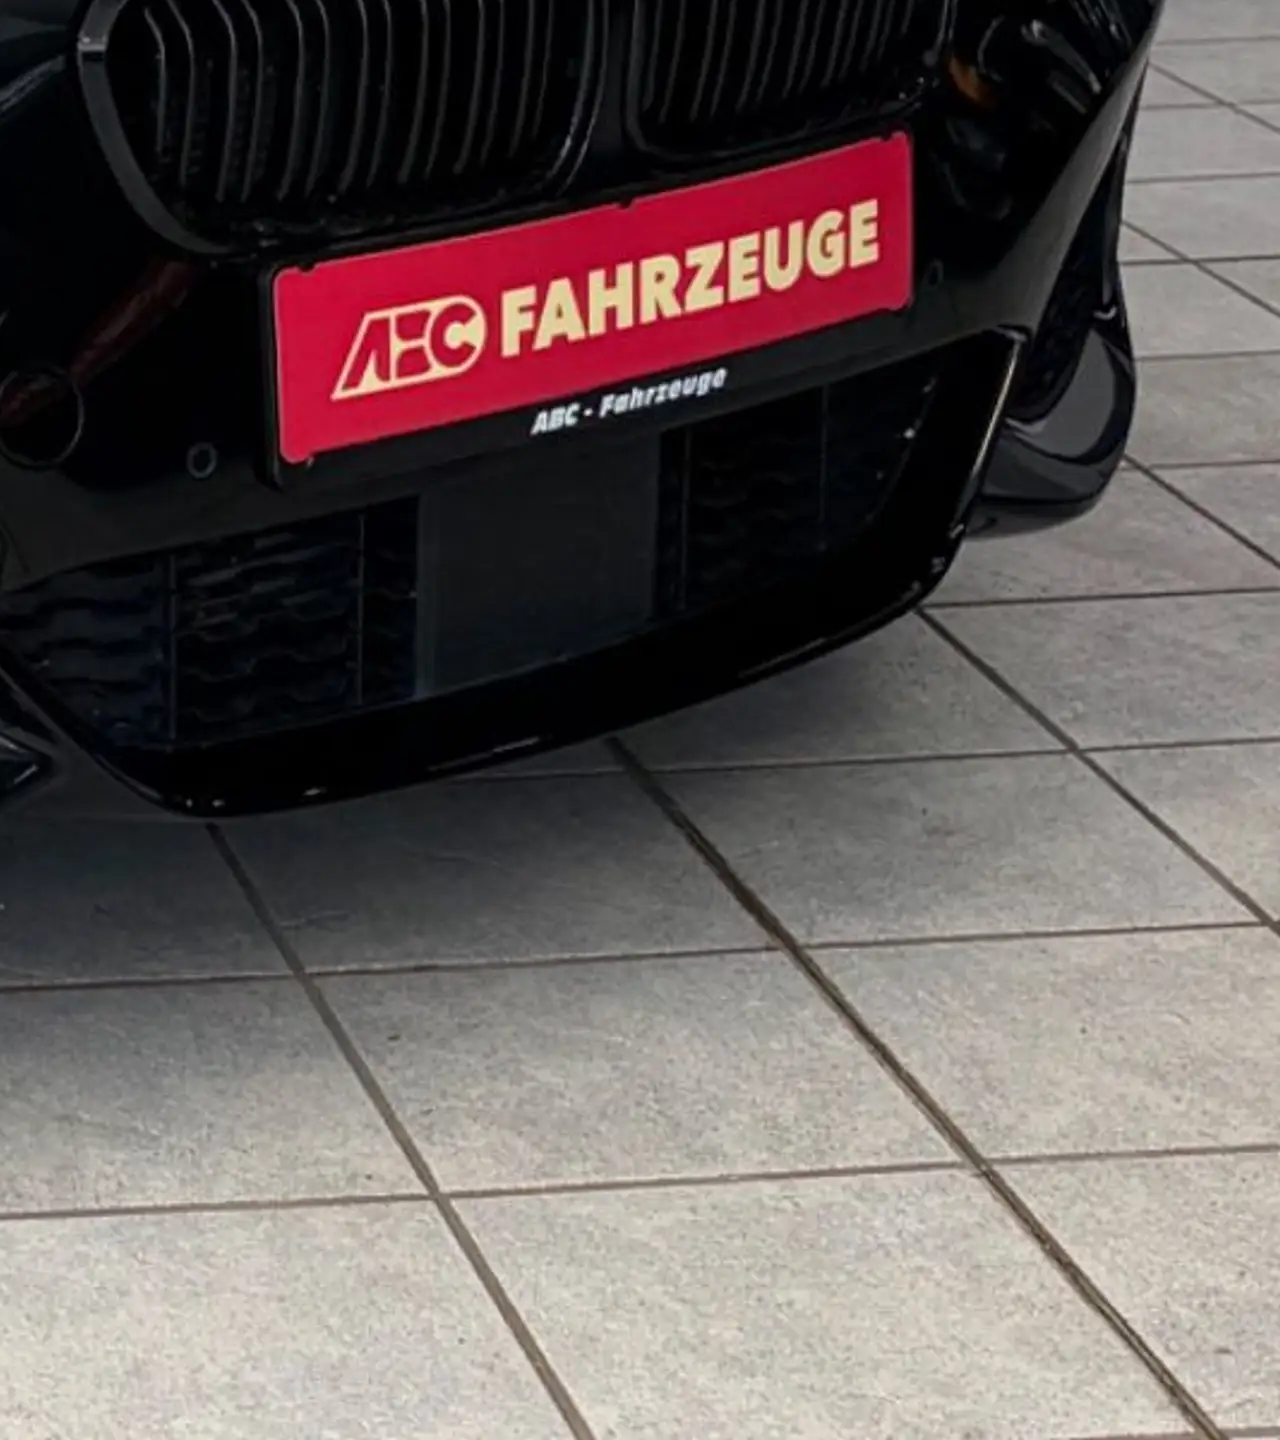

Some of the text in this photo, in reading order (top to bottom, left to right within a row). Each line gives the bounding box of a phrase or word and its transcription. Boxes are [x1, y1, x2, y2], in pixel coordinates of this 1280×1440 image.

[501, 199, 879, 358] FAHRZEUGE
[530, 402, 581, 435] ABC
[598, 367, 728, 419] Fahrzeuge
